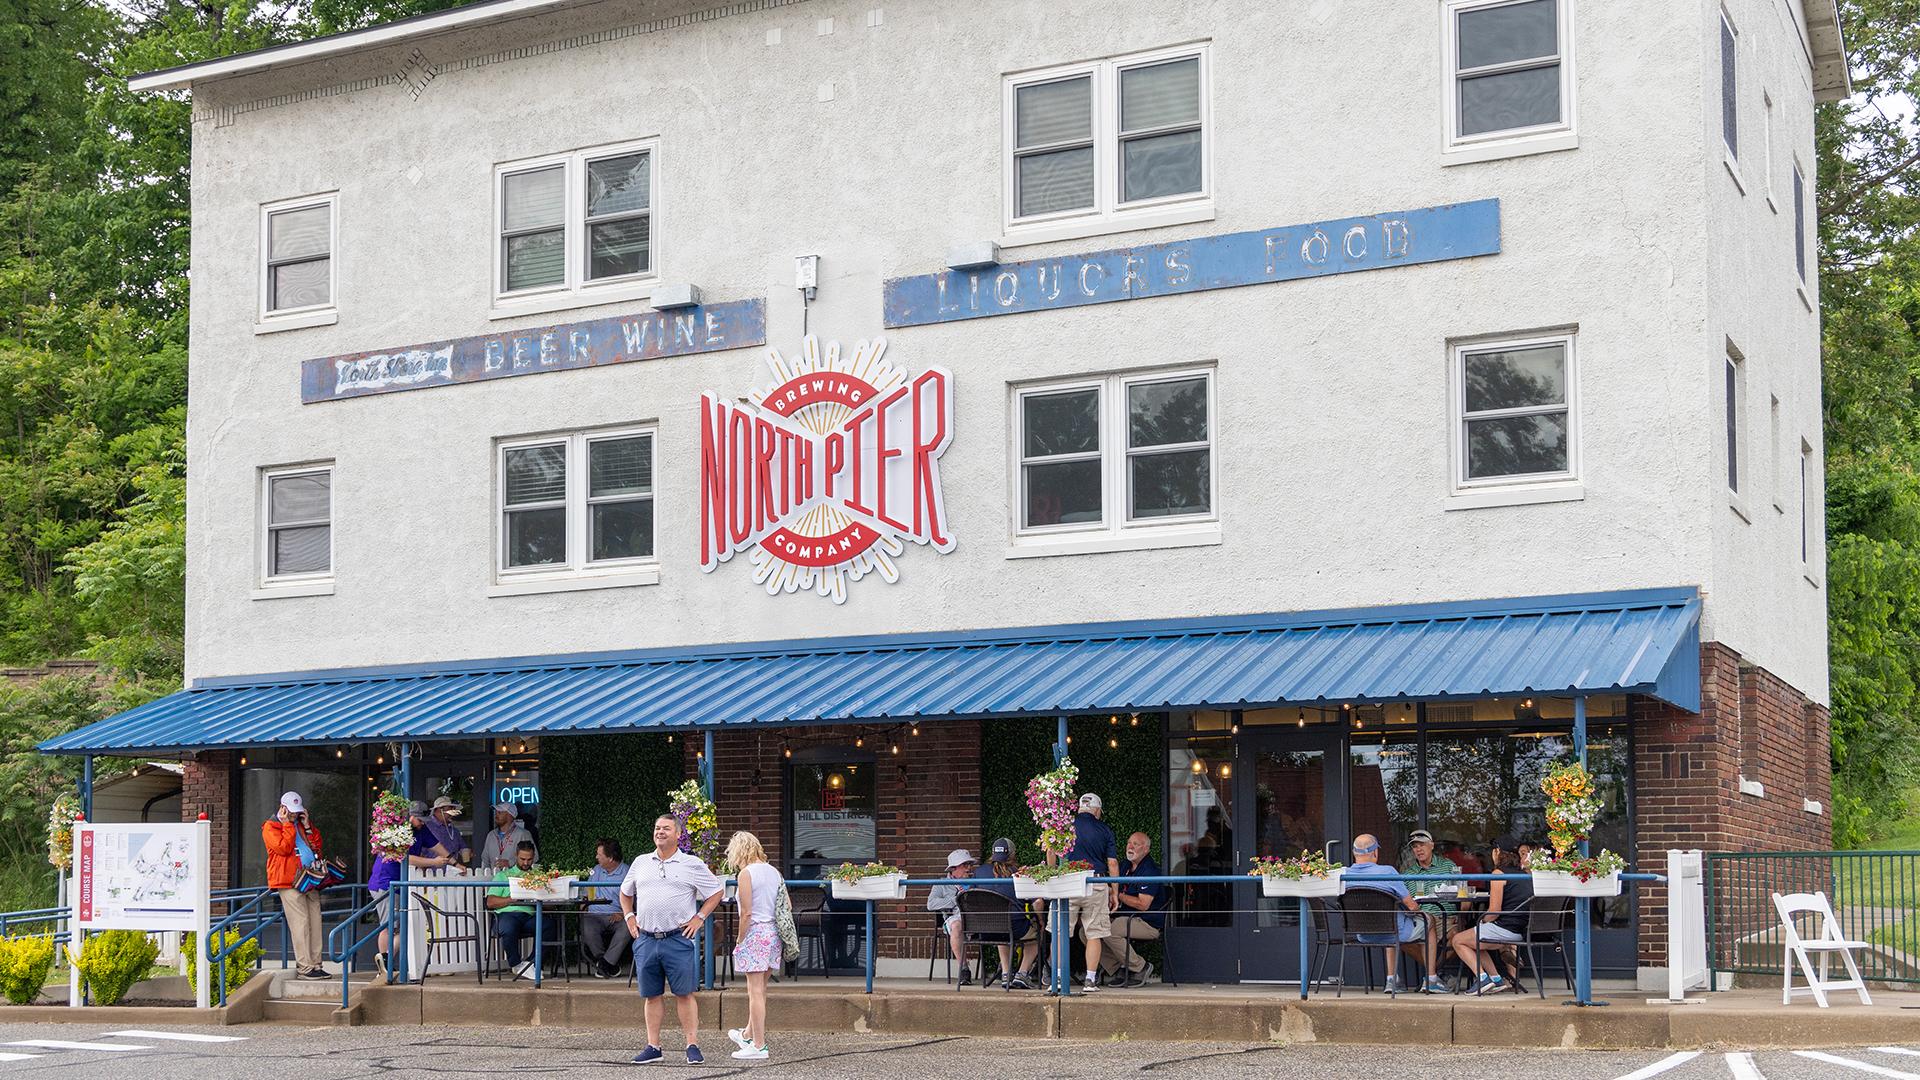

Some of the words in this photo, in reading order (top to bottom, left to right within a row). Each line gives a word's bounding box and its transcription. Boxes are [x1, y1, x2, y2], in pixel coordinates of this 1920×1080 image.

[937, 249, 1191, 314] LIQUORS
[1264, 219, 1410, 274] FOOD
[484, 330, 592, 373] BEER
[621, 311, 725, 355] WINE
[774, 379, 863, 412] BREWING
[700, 393, 814, 567] NORTH
[824, 369, 949, 546] PIER
[774, 526, 863, 560] COMPANY
[500, 787, 539, 803] OPEN
[798, 812, 820, 820] HILL
[83, 854, 91, 874] MAP
[83, 874, 91, 904] COURSE
